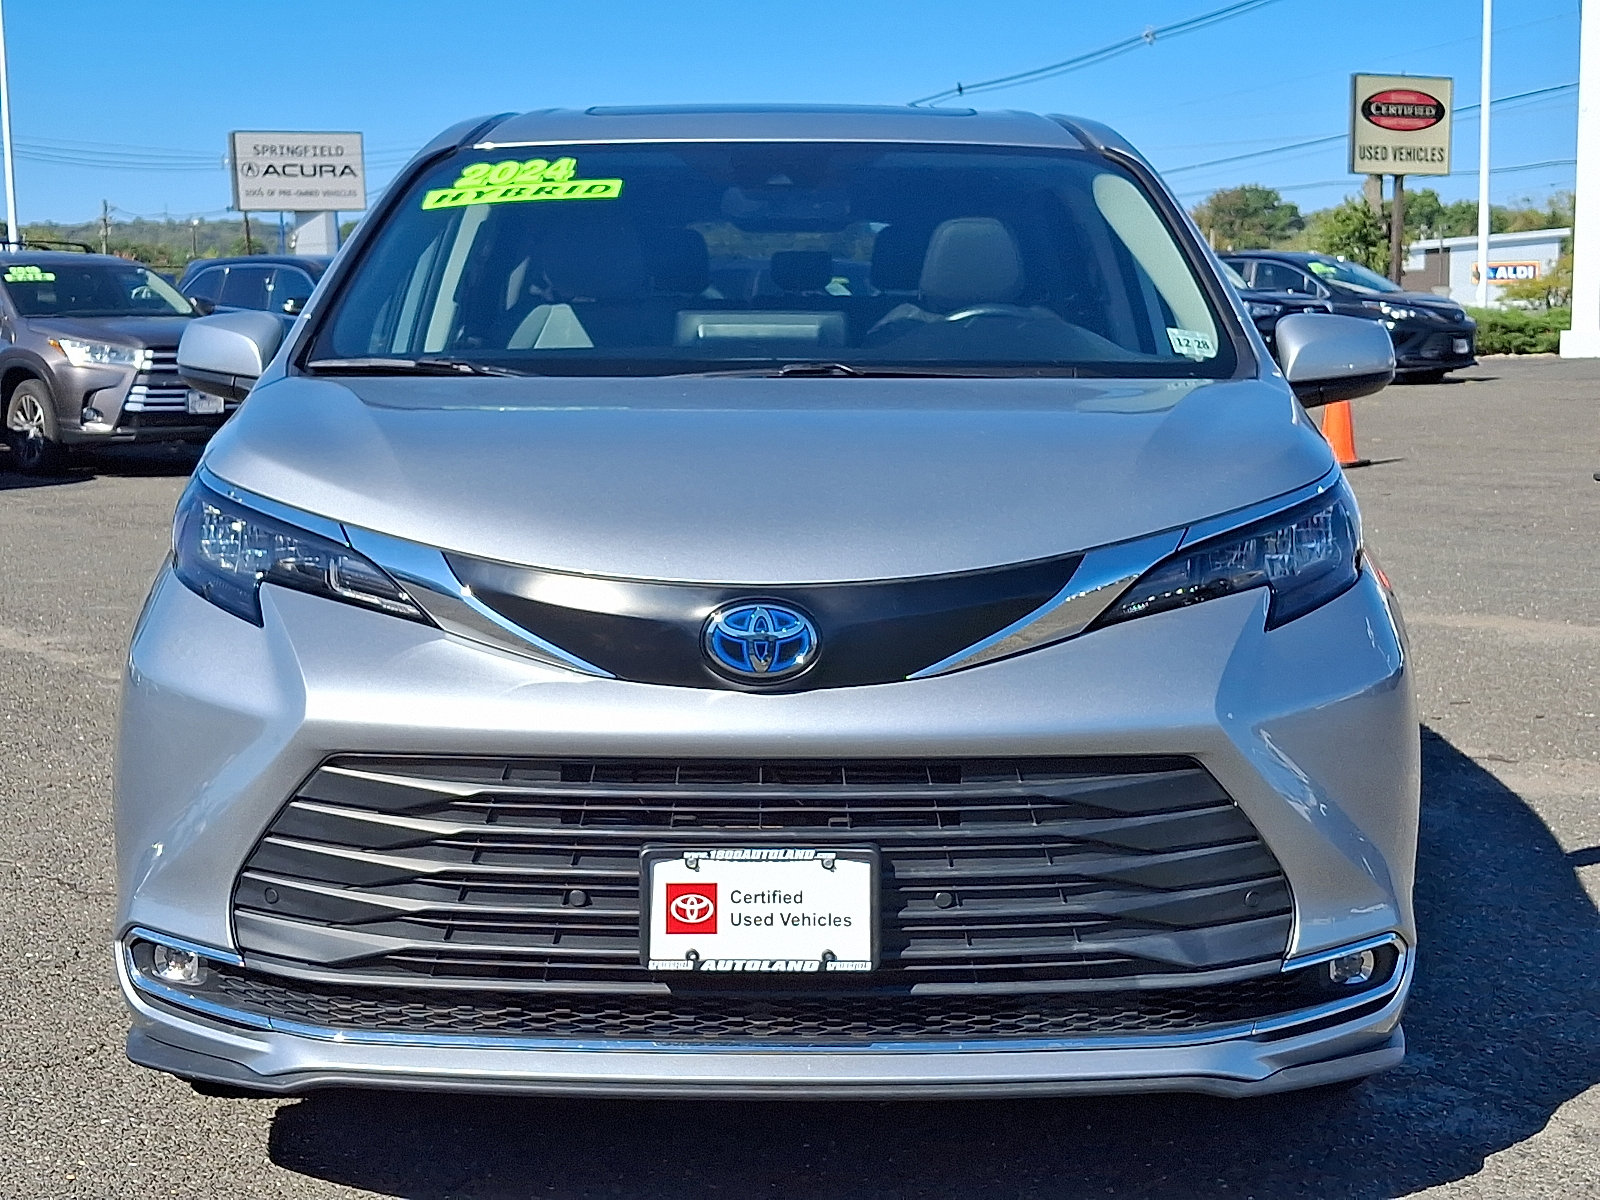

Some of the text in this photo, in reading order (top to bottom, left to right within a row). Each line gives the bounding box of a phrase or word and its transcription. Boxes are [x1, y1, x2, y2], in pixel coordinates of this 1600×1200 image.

[253, 144, 344, 157] SPRINGFIELD
[1359, 146, 1445, 163] USED VEHICLES
[262, 164, 358, 178] ACURA
[453, 157, 578, 189] 2024
[432, 183, 613, 205] HYBRID
[1496, 266, 1535, 279] ALDI
[1176, 337, 1210, 350] 12 28
[730, 889, 804, 905] Certified
[730, 912, 853, 927] Used Vehicles
[700, 959, 820, 972] AUTOLAND
